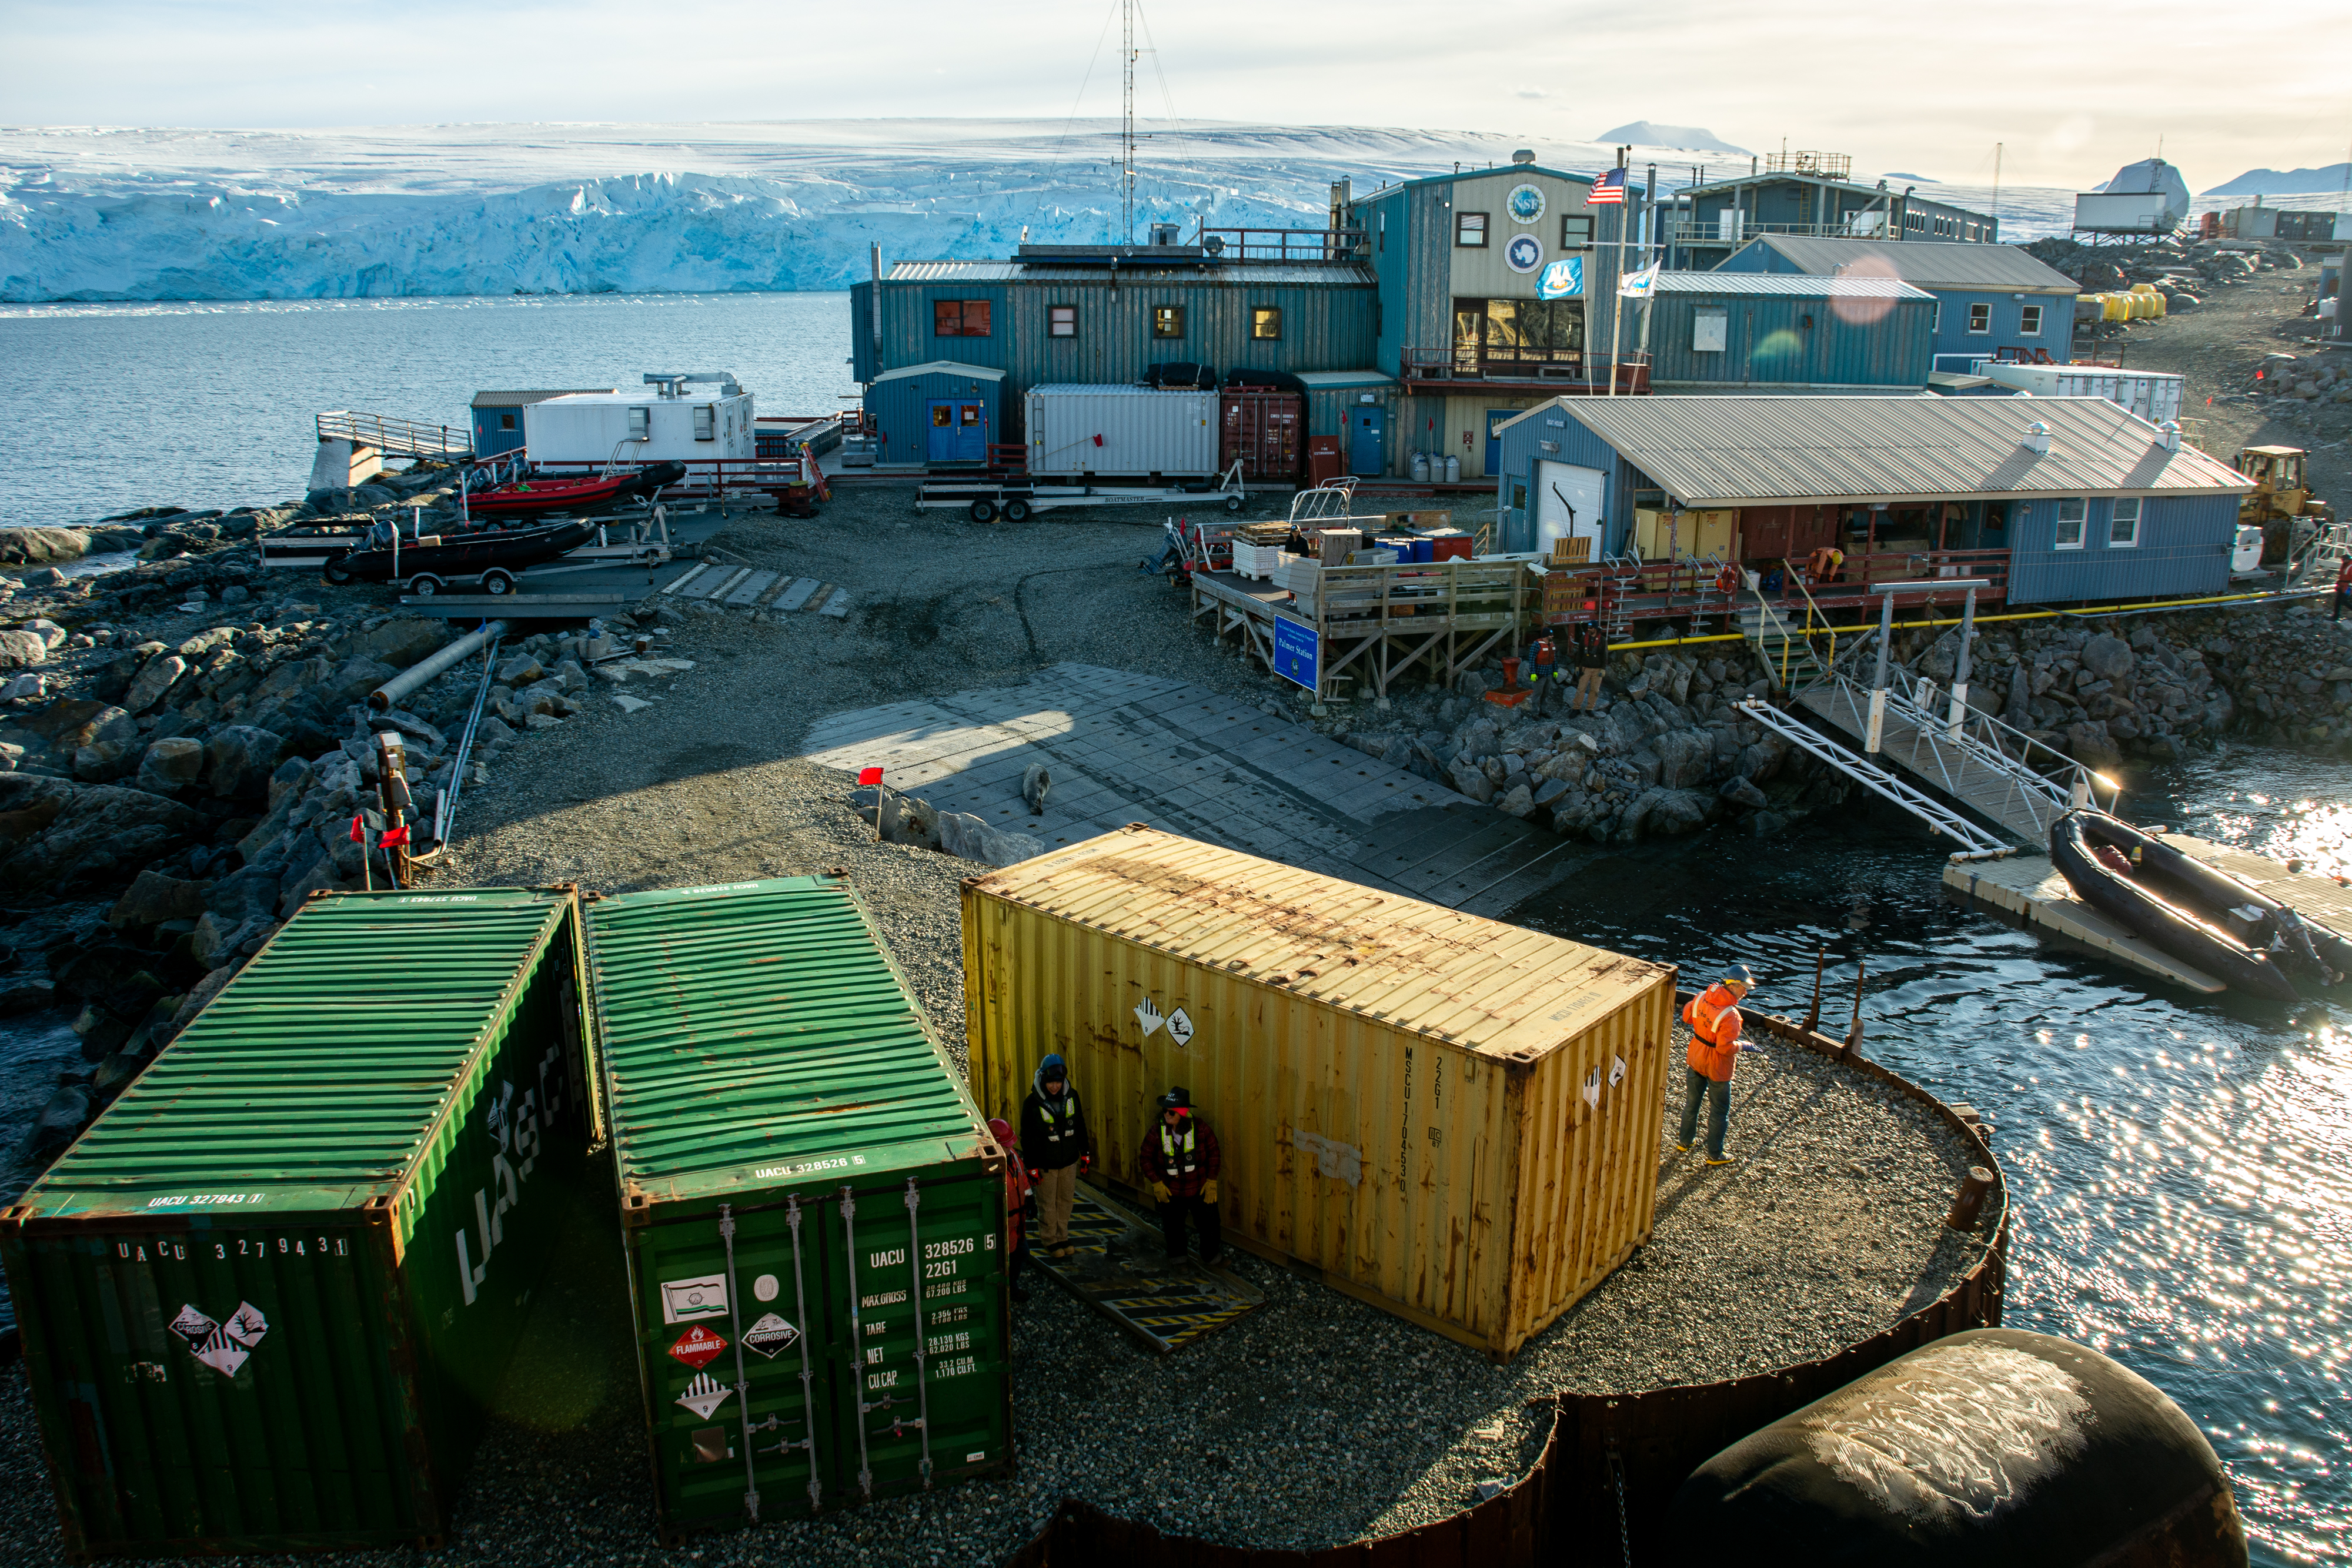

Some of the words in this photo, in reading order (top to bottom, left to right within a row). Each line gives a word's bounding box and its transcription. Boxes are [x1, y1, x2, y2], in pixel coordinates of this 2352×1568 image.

[1514, 199, 1539, 210] NSF
[1279, 637, 1295, 652] Palmer
[1295, 645, 1312, 660] Station
[1566, 996, 1595, 1011] 170453
[755, 1166, 791, 1178] UACU
[796, 1158, 848, 1174] 328526
[853, 1155, 864, 1165] 5
[148, 1196, 189, 1207] UACU
[189, 1194, 246, 1205] 327943
[118, 1241, 185, 1261] UACU
[215, 1237, 328, 1259] 327943
[871, 1249, 905, 1268] UACU
[925, 1238, 974, 1259] 328526
[985, 1234, 995, 1249] 5
[926, 1259, 956, 1278] 22G1
[862, 1290, 906, 1308] MAX.GROSS
[926, 1282, 950, 1290] 30.480
[926, 1287, 950, 1298] 67.200
[953, 1284, 966, 1293] LBS
[749, 1329, 792, 1343] CORROSIVE
[866, 1321, 886, 1336] TARE
[676, 1340, 721, 1355] FLAMMABLE
[867, 1346, 884, 1365] NET
[928, 1334, 953, 1346] 28.130
[956, 1332, 969, 1342] KGS
[929, 1343, 953, 1355] 62.020
[956, 1340, 970, 1350] LBS
[868, 1370, 898, 1389] CU.CAP.
[939, 1359, 954, 1368] 33.2
[957, 1356, 974, 1365] CU.M.
[936, 1367, 955, 1378] 1.170
